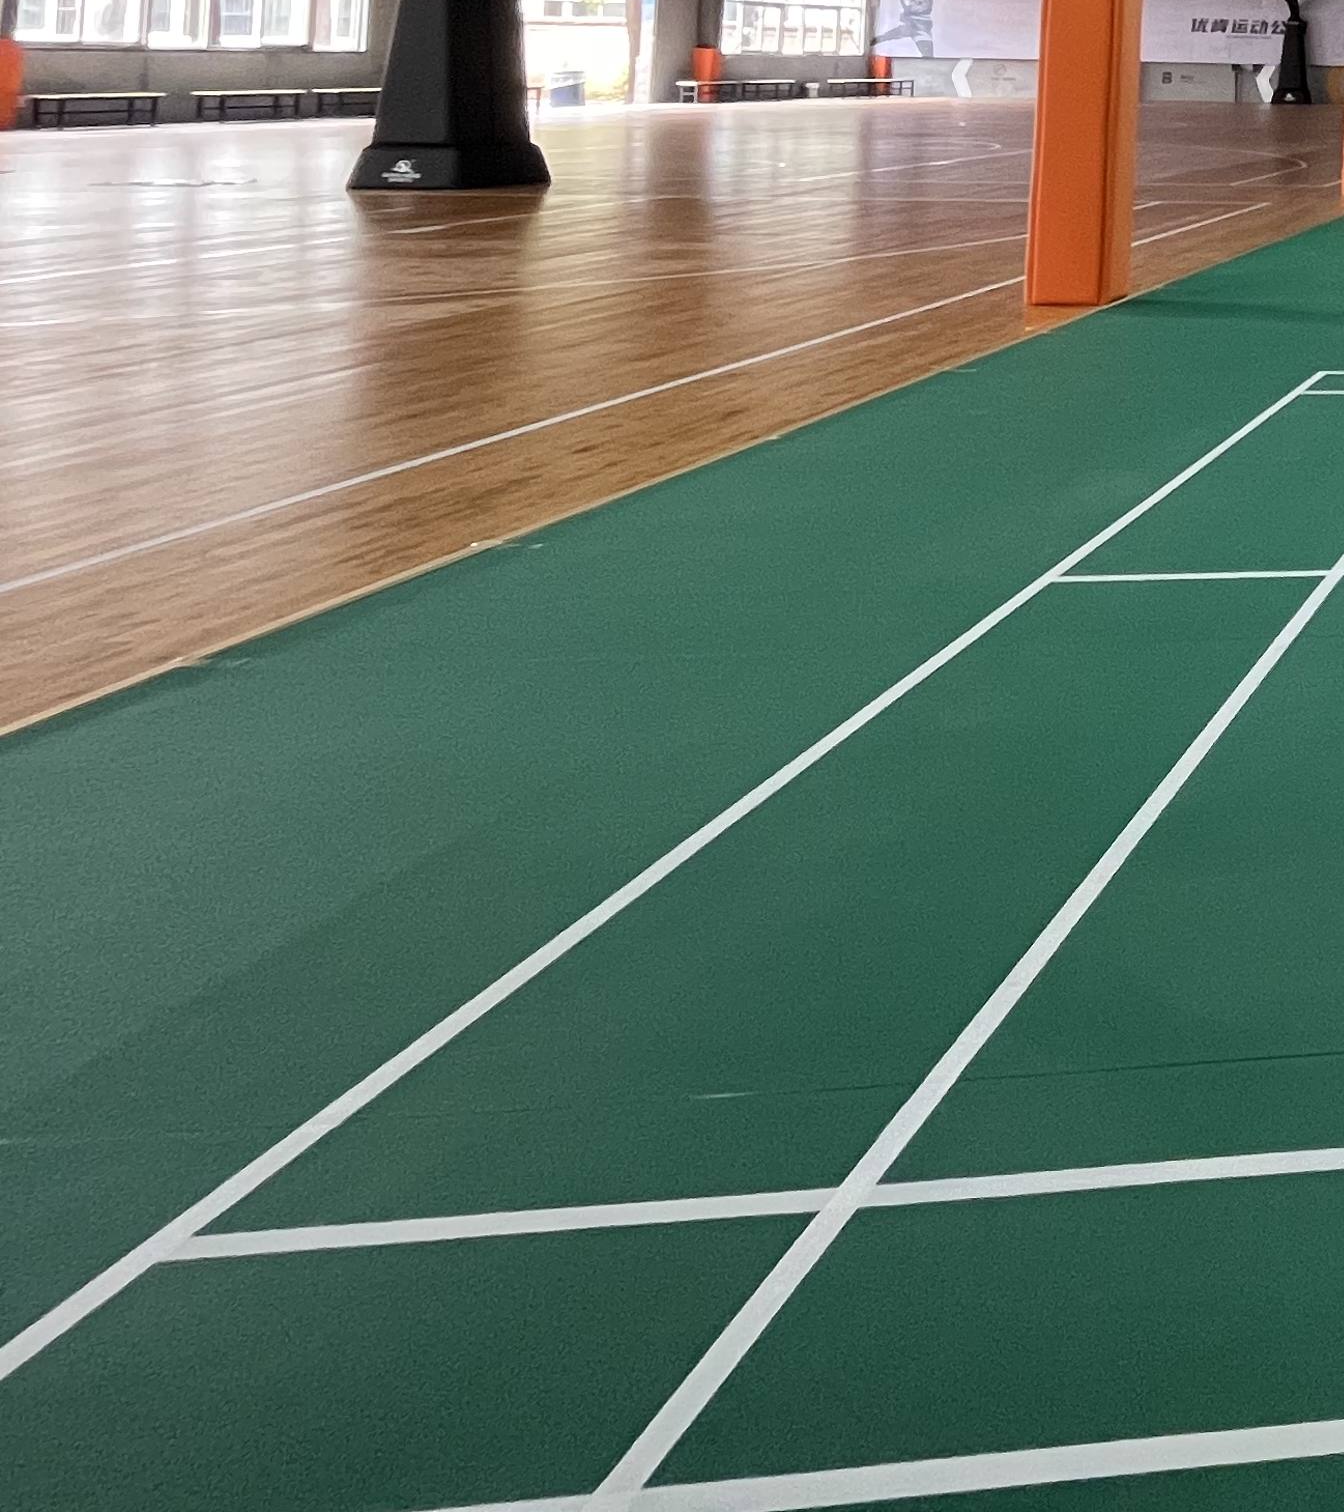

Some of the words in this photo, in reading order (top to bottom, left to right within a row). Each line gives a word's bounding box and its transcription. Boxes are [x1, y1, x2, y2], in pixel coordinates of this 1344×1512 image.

[1191, 18, 1286, 35] 优肯运动公
